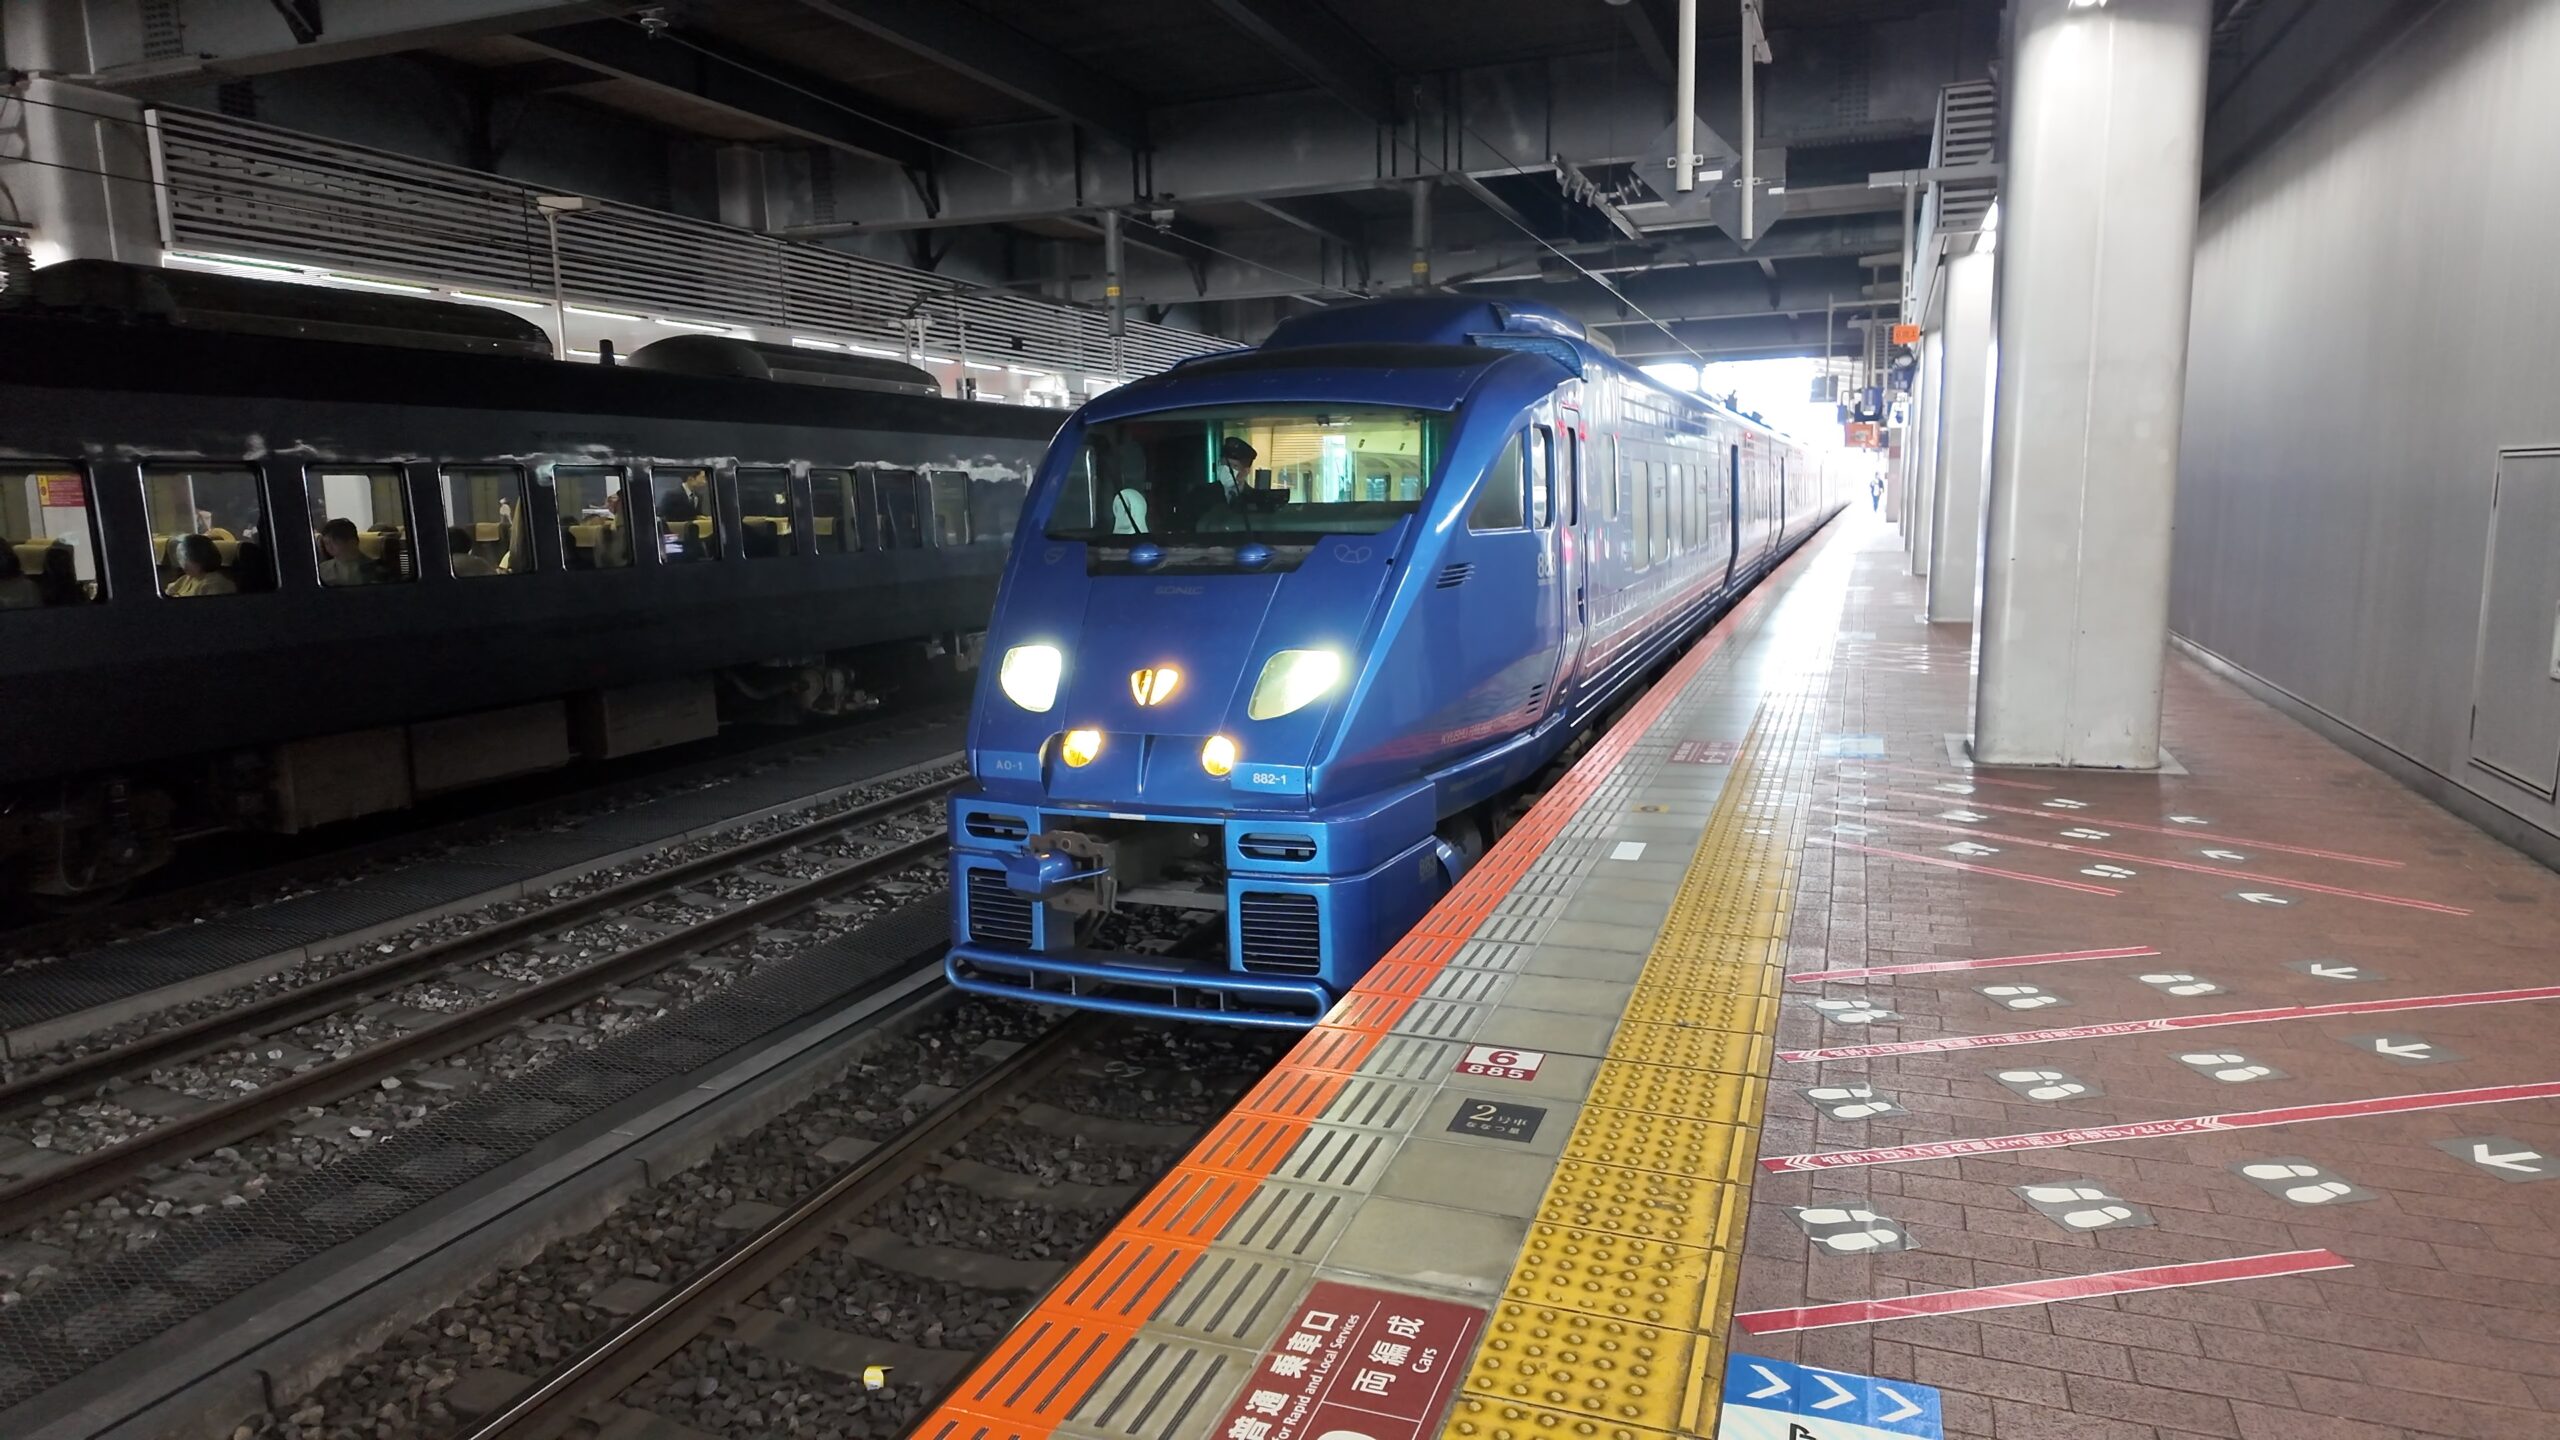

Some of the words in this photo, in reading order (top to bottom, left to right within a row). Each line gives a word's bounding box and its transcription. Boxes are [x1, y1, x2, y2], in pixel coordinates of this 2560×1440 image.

[1154, 585, 1204, 595] SONIC
[1252, 772, 1287, 785] 882-1
[1488, 1050, 1520, 1066] 6
[1467, 1064, 1525, 1079] 885
[1351, 1315, 1425, 1397] 両編成
[1411, 1347, 1438, 1374] Cars
[1228, 1389, 1290, 1440] 普通
[1270, 1310, 1339, 1379] 乗車口
[1282, 1394, 1311, 1426] Rapid
[1305, 1375, 1321, 1396] and
[1314, 1345, 1336, 1375] Local
[1330, 1313, 1360, 1350] Services
